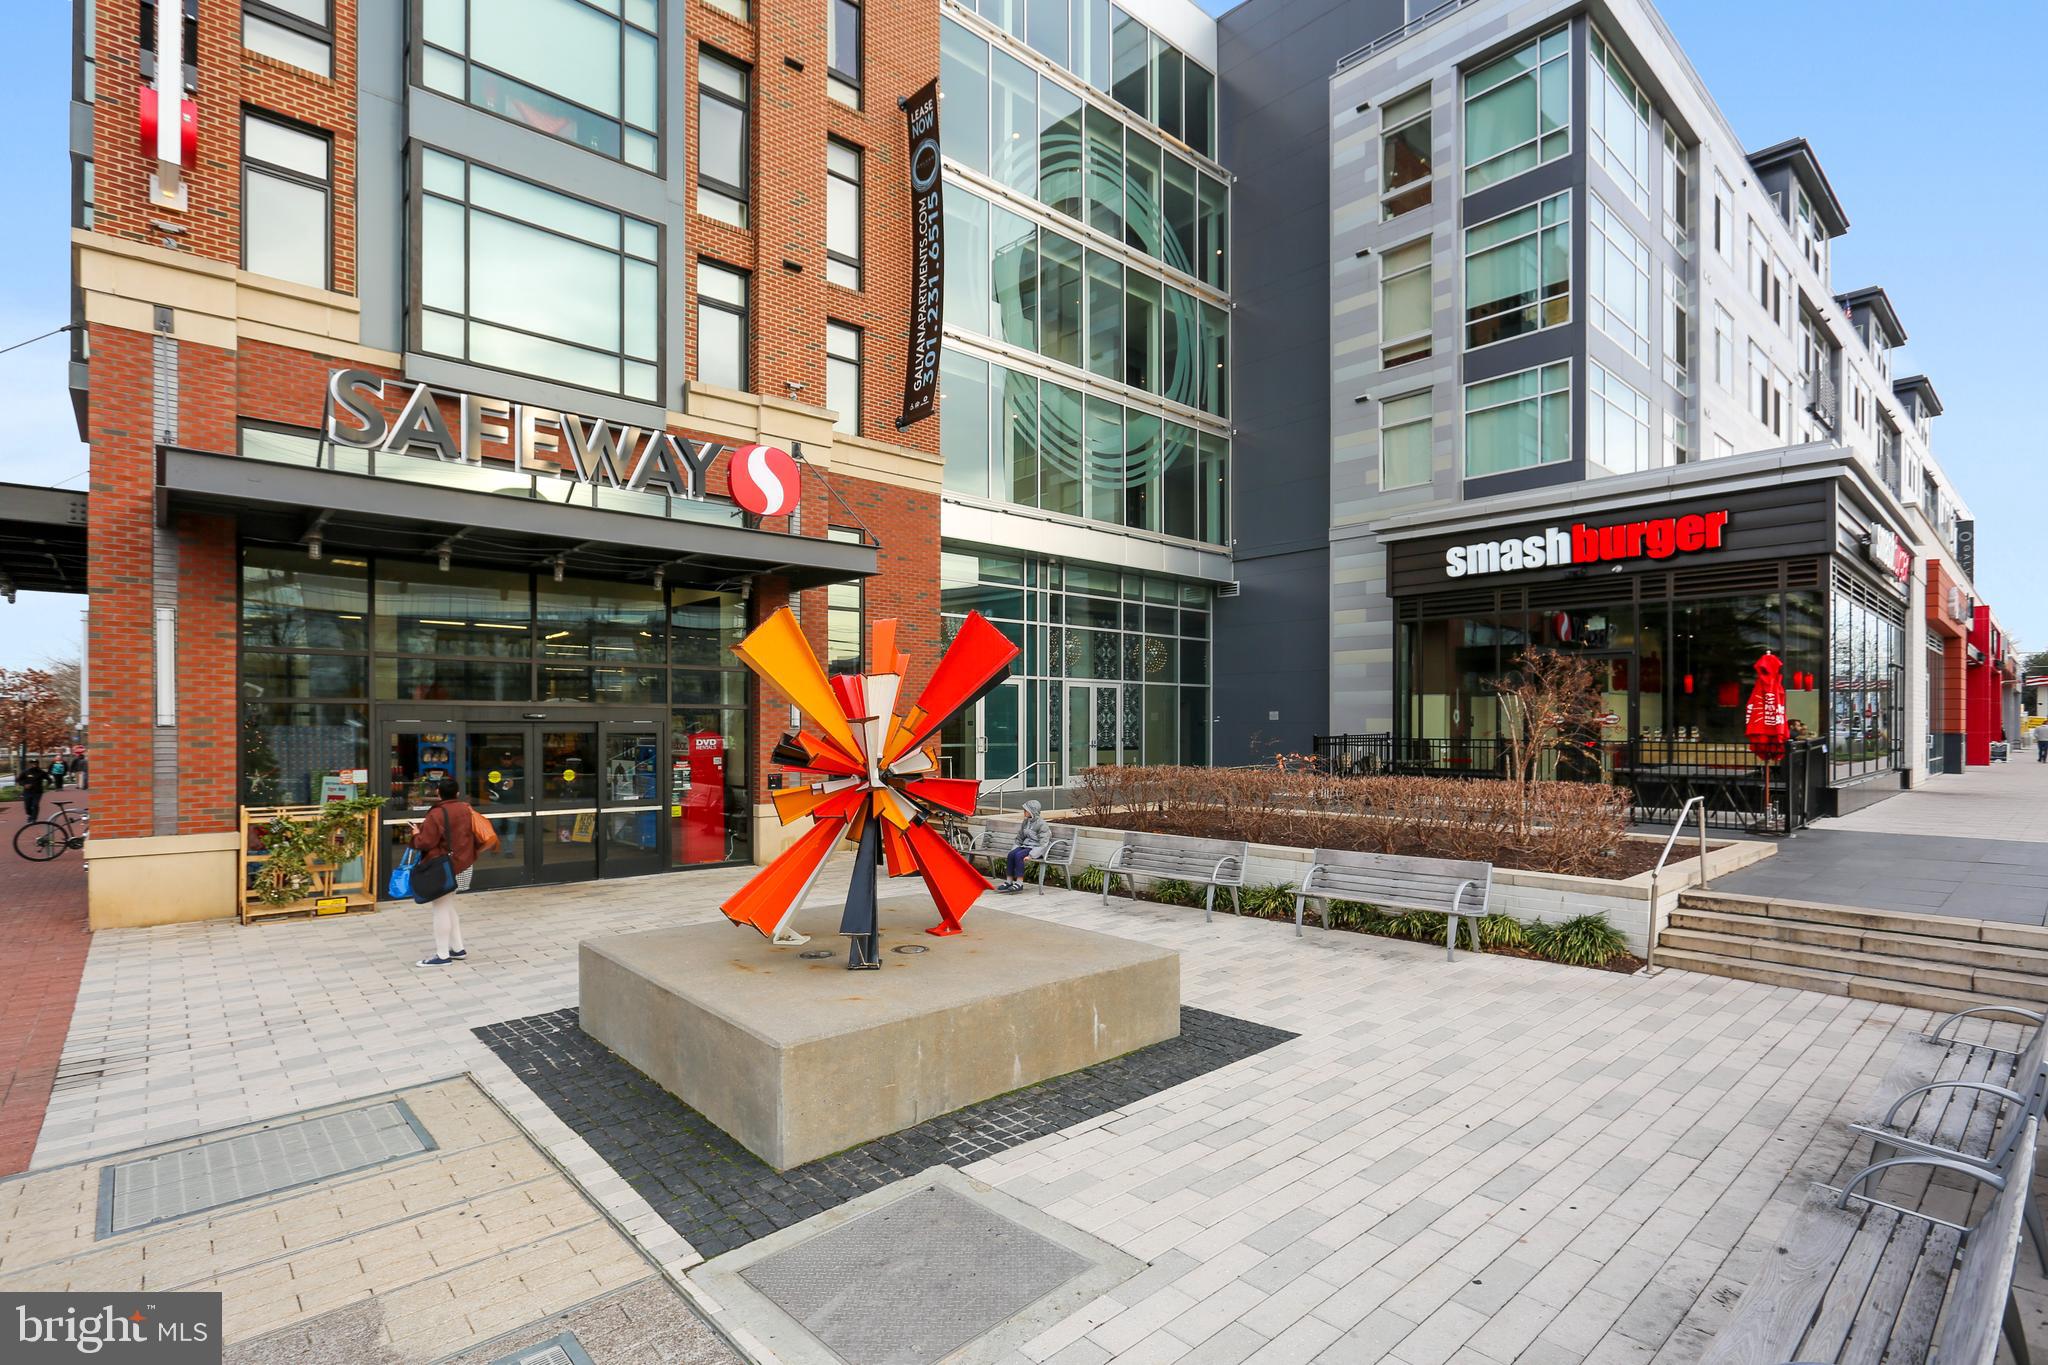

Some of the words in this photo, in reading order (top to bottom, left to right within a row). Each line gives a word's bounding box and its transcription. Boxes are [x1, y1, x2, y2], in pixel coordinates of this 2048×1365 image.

[911, 98, 934, 124] LEASE
[911, 111, 934, 139] NOW
[913, 196, 929, 392] GALVANAPARTMENTS.COM
[328, 368, 725, 502] SAFEWAY
[1445, 509, 1728, 578] smashburger
[695, 738, 717, 746] DVD
